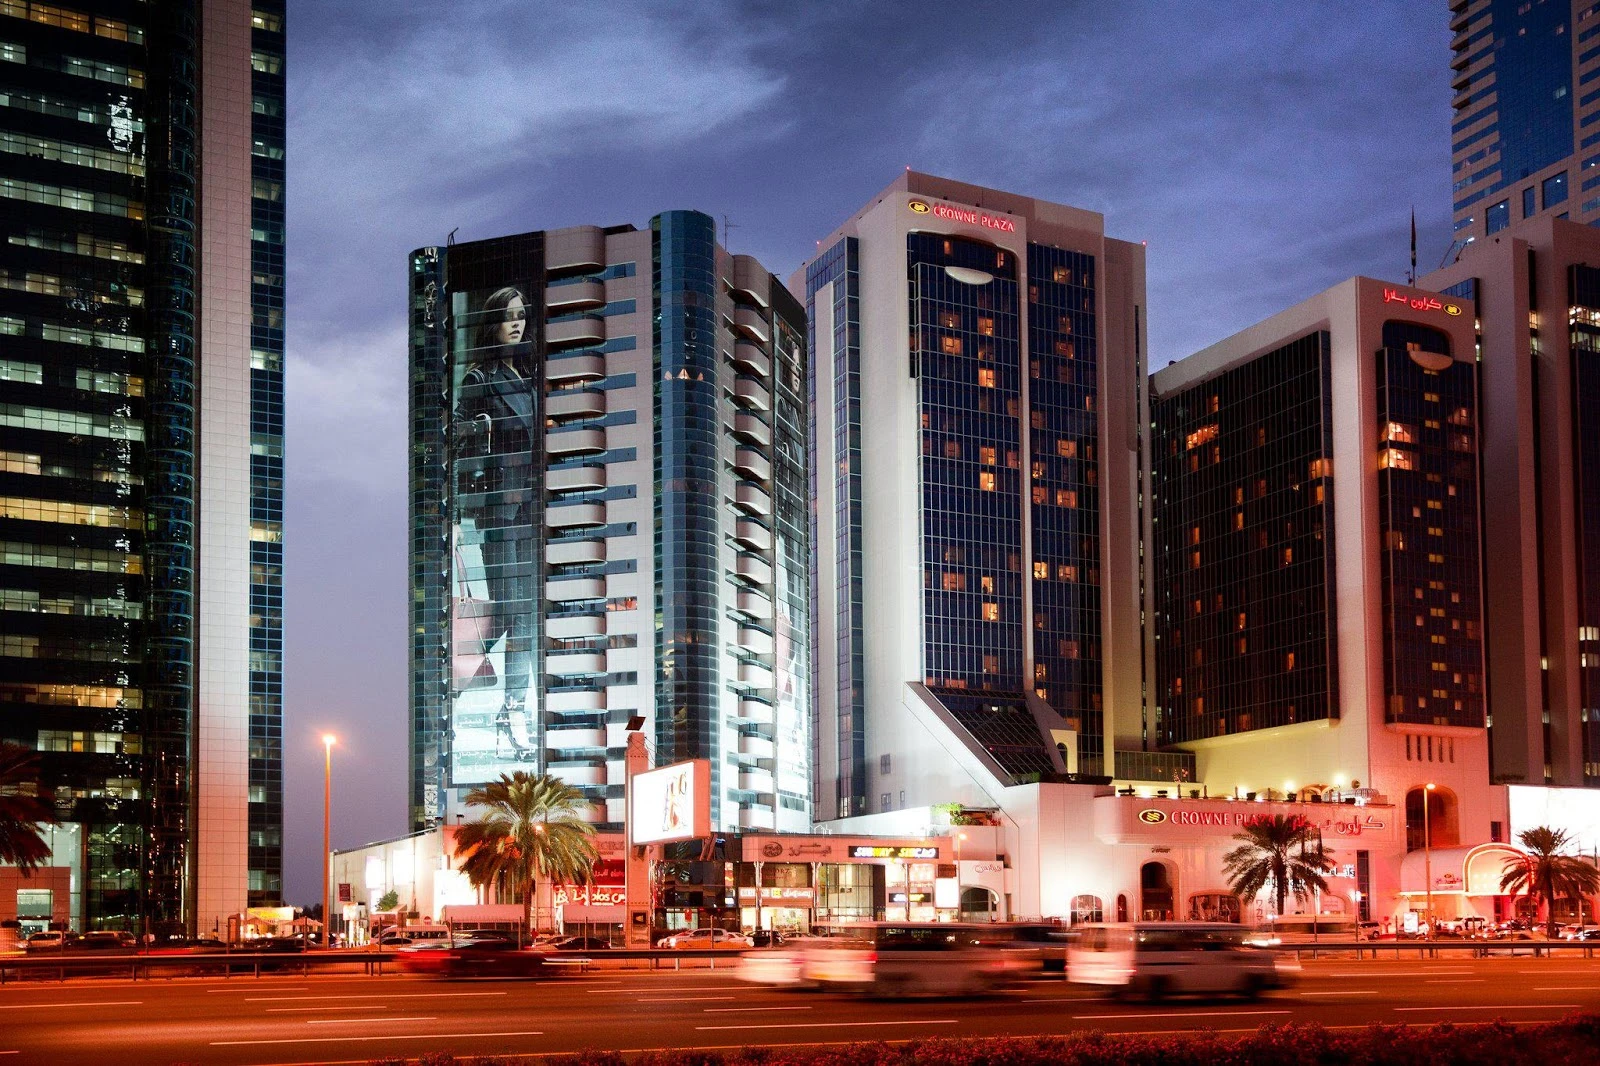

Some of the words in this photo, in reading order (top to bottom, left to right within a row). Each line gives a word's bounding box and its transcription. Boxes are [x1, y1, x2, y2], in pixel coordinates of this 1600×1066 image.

[933, 205, 977, 224] CROWNE
[981, 216, 1015, 232] PLAZA
[1384, 288, 1408, 303] بلازا
[1411, 296, 1442, 310] كراون
[1171, 811, 1230, 826] CROWNE
[1235, 812, 1276, 828] PLAZA
[1336, 815, 1386, 835] كراون
